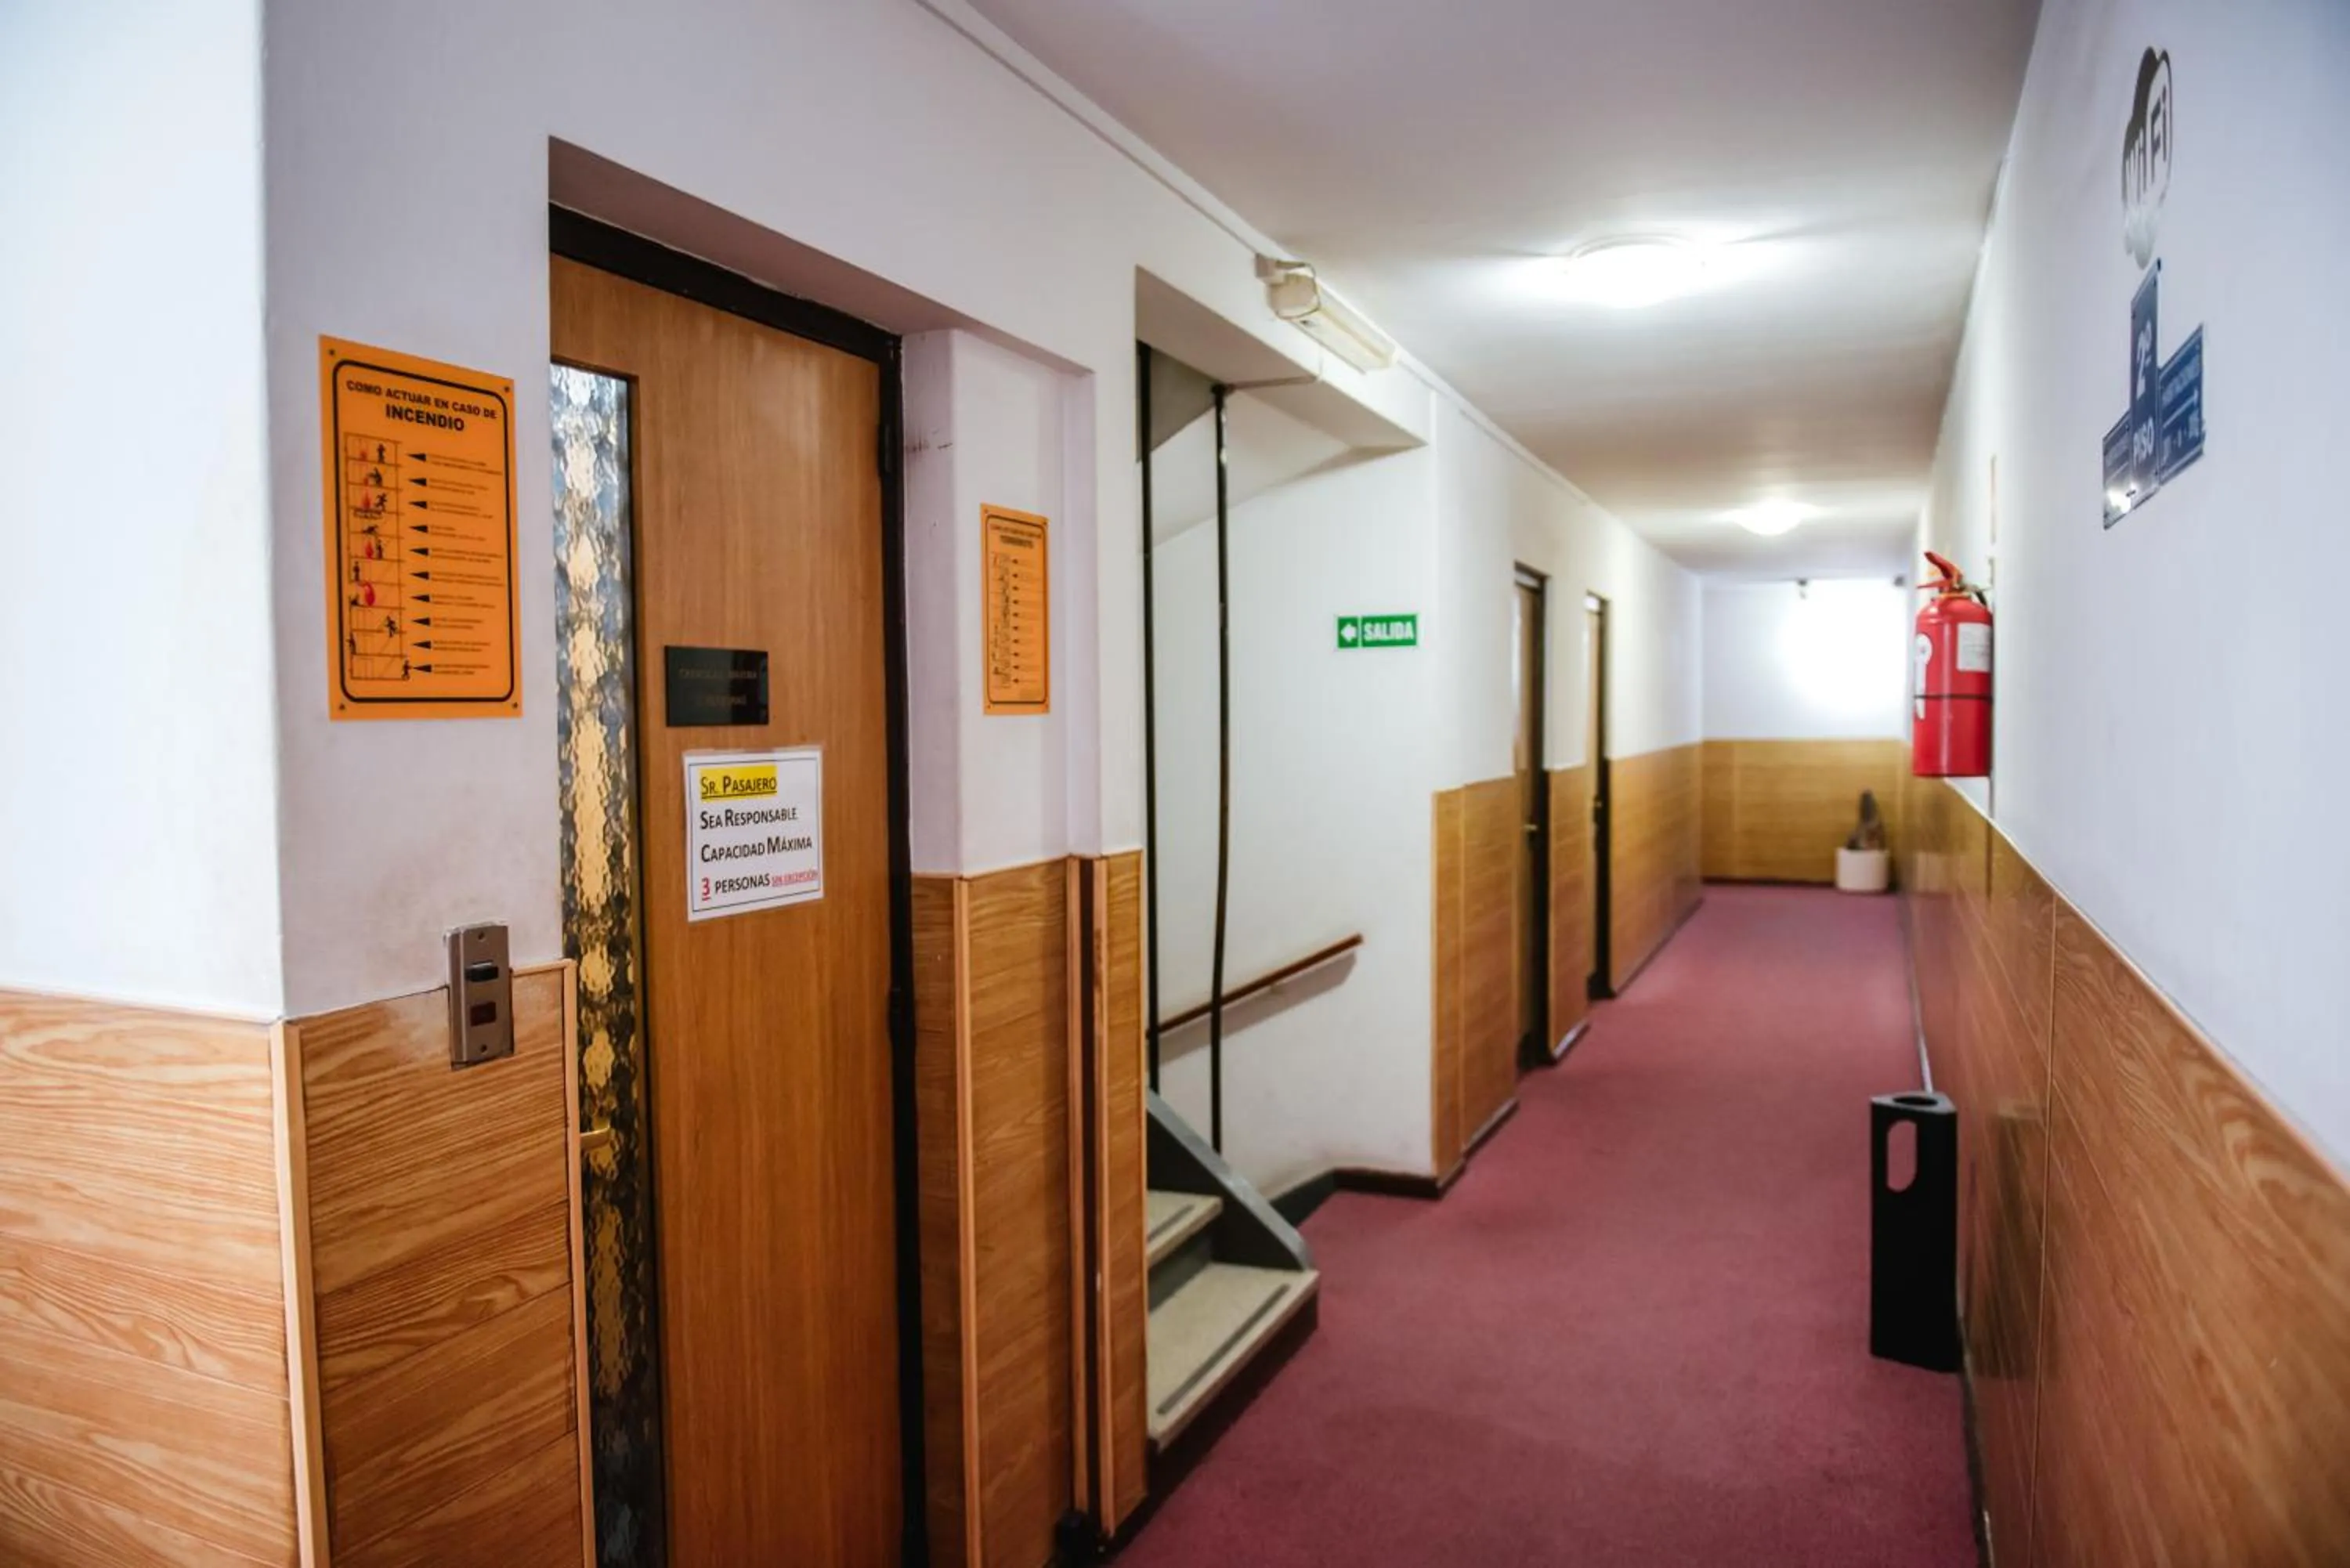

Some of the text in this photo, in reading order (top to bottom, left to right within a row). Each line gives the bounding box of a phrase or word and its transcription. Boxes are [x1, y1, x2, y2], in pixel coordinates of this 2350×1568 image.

[346, 380, 497, 419] COMO ACTUAR EN CASO DE
[386, 403, 465, 432] INCENDIO
[1364, 620, 1415, 641] SALIDA
[722, 775, 778, 794] PASAJERO
[700, 807, 798, 830] SEA RESPONSABLE
[701, 844, 765, 863] CAPACIDAD
[701, 876, 710, 897] 3
[714, 873, 770, 894] PERSONAS
